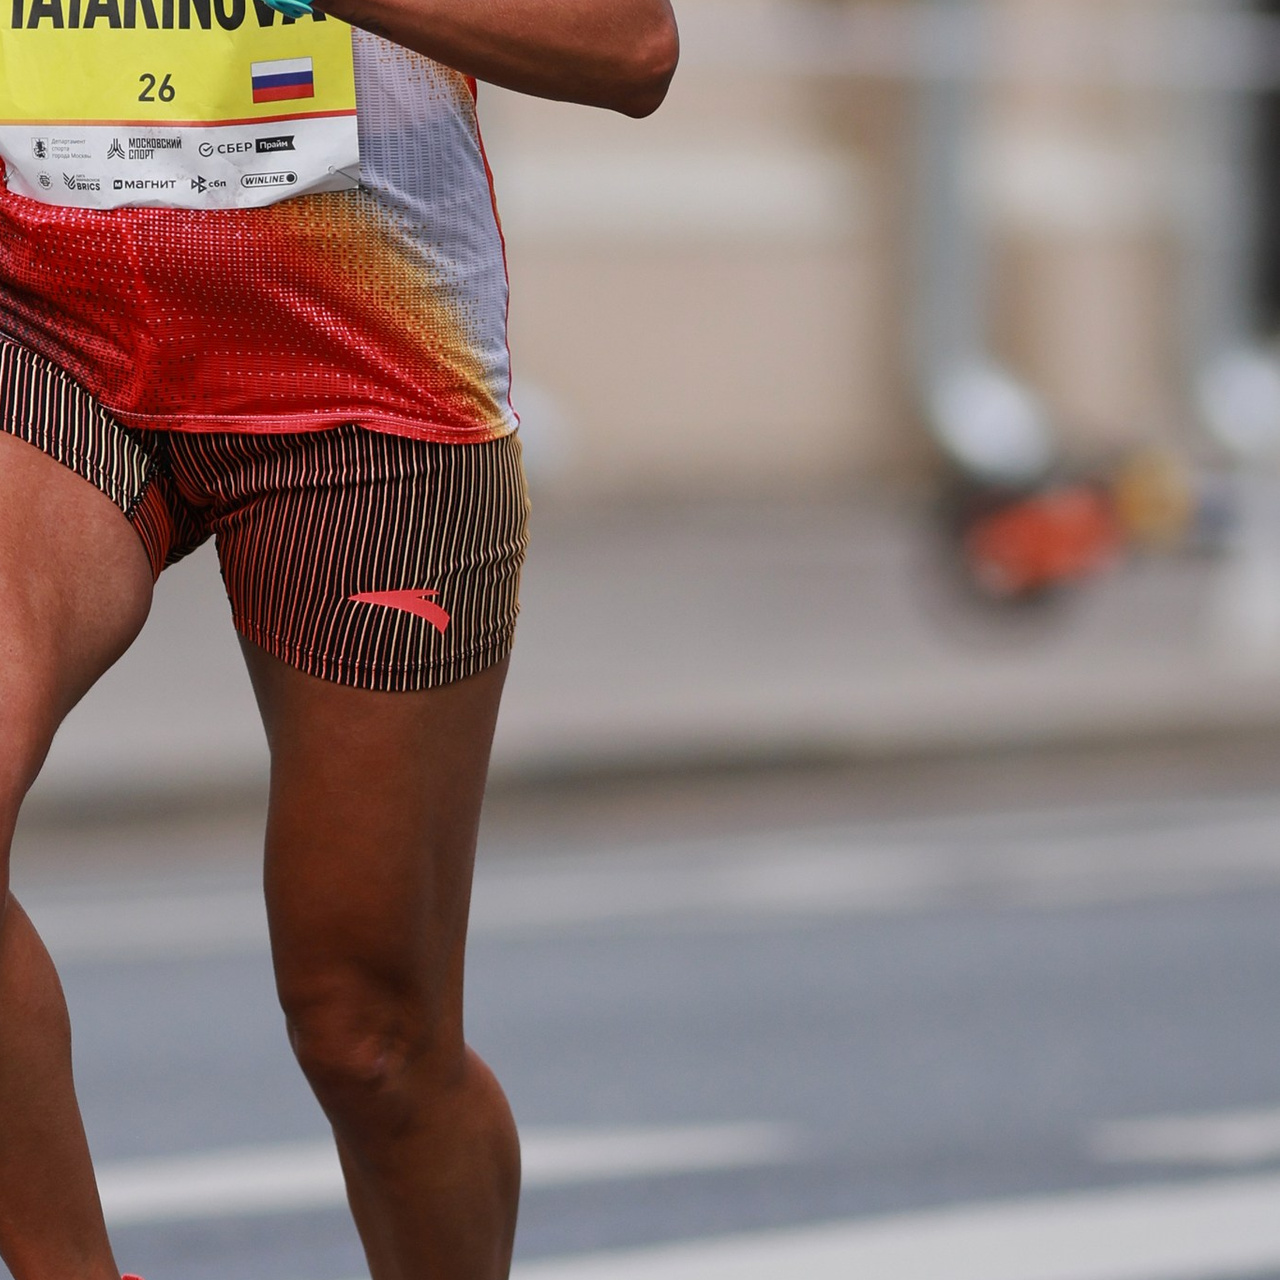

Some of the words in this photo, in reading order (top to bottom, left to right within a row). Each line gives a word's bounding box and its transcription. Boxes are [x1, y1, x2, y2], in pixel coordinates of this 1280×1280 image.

[137, 73, 176, 103] 26
[128, 137, 182, 149] МОСКОВСКИЙ
[217, 142, 253, 154] СБЕР
[259, 139, 288, 150] Прайм
[128, 149, 154, 160] СПОРТ
[245, 174, 285, 185] WINLINE
[77, 182, 100, 191] BRICS
